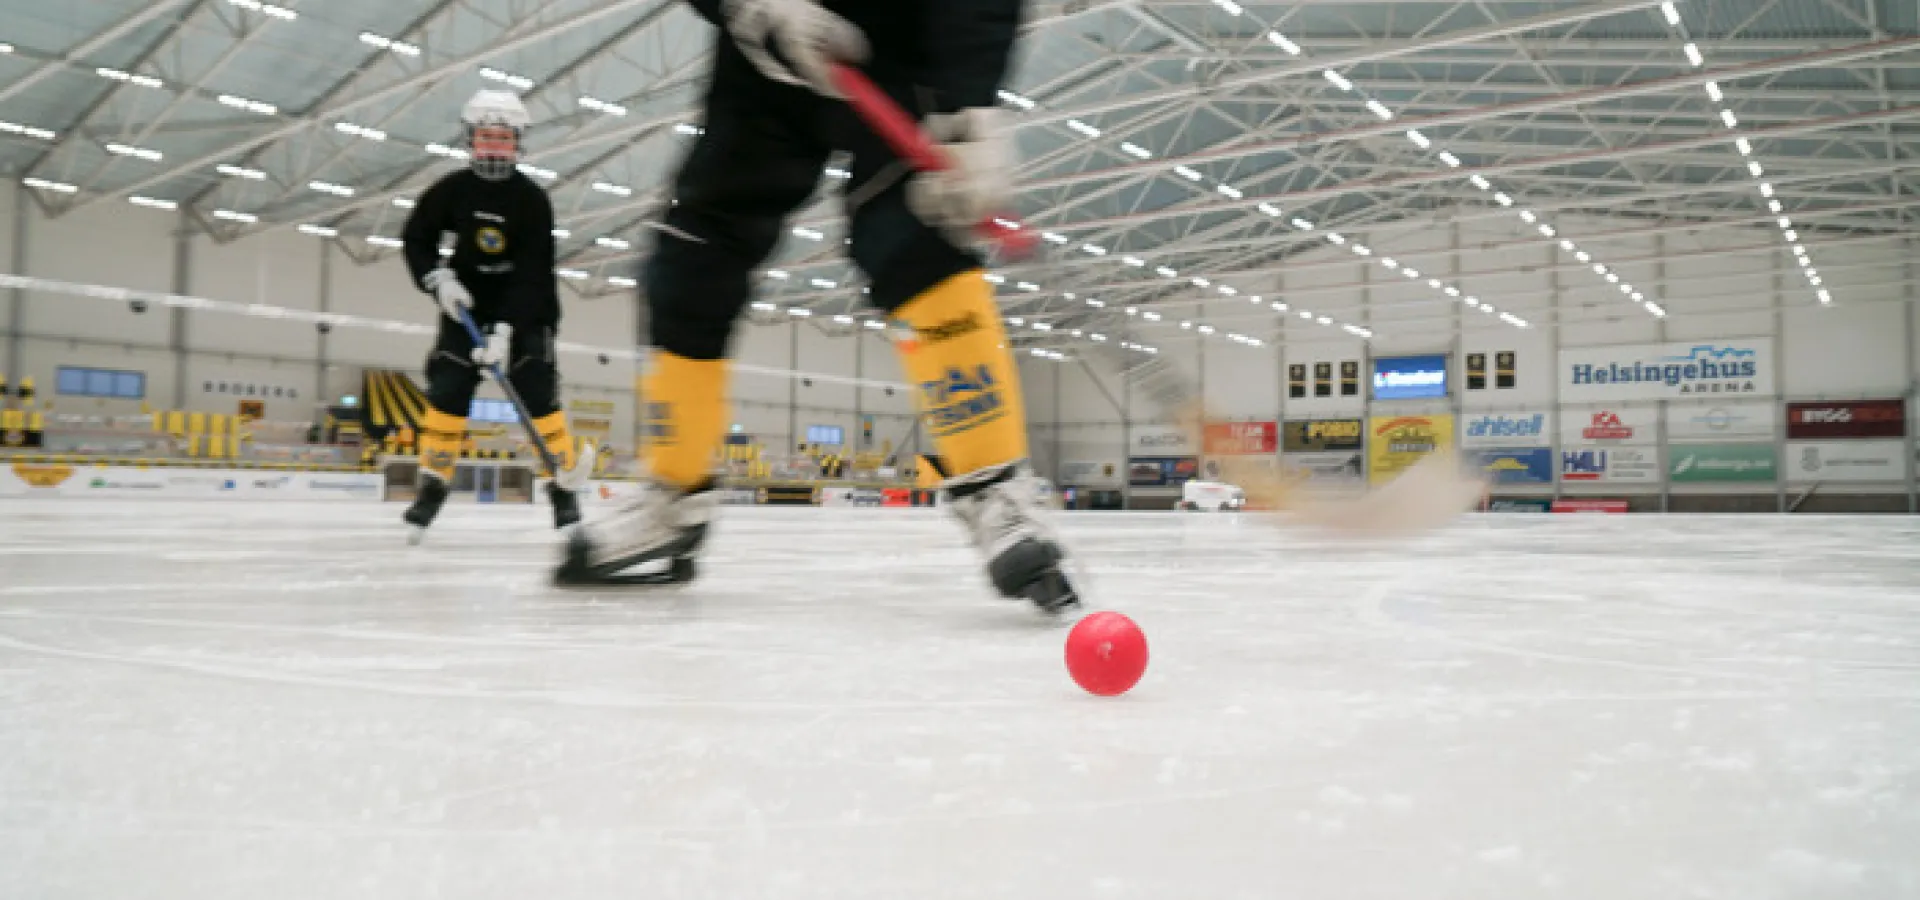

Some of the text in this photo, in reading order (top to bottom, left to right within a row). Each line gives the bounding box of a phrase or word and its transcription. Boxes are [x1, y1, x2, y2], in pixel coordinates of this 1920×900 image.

[1571, 359, 1756, 387] Helsingehus
[202, 380, 299, 399] BROBERG
[1680, 381, 1756, 394] ARENA
[1591, 409, 1622, 426] ICA
[1801, 407, 1853, 423] BYGG
[1466, 413, 1544, 437] ahlsell
